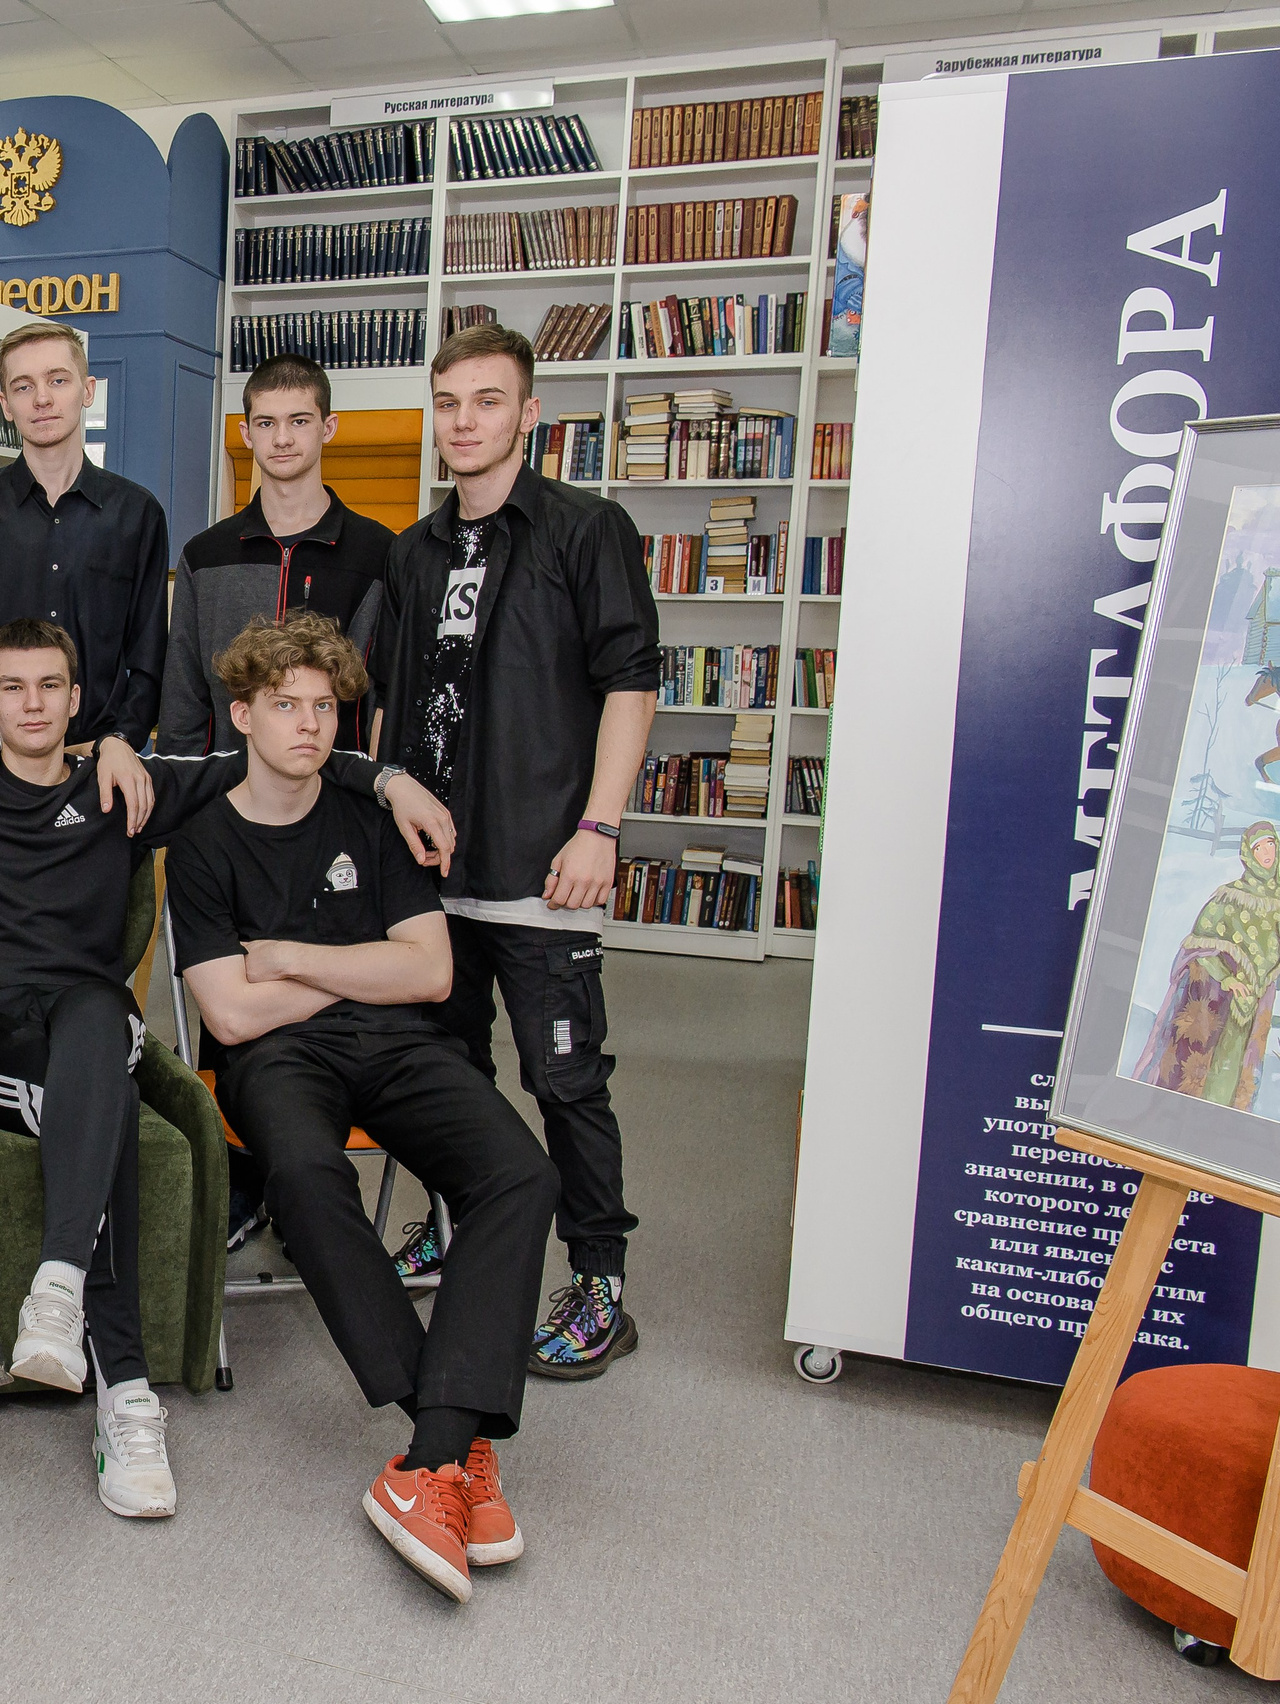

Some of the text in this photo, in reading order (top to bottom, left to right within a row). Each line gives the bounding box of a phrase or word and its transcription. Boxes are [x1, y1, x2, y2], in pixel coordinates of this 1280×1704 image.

[935, 47, 1103, 73] Зарубежная литература
[384, 93, 494, 114] Русская литература
[685, 661, 694, 704] ПАСТЕРНАК
[54, 813, 86, 828] adidas
[571, 948, 596, 960] BLACK
[965, 1163, 1094, 1193] значении,
[1102, 1180, 1115, 1192] в
[984, 1190, 1099, 1214] которого
[954, 1210, 1086, 1237] сравнение
[990, 1238, 1038, 1255] или
[1160, 1260, 1174, 1274] с
[955, 1256, 1107, 1290] каким-либо
[48, 1281, 75, 1296] Reebok
[961, 1304, 1052, 1328] общего
[971, 1283, 1001, 1297] на
[1151, 1308, 1186, 1326] их
[125, 1397, 151, 1406] Reebok
